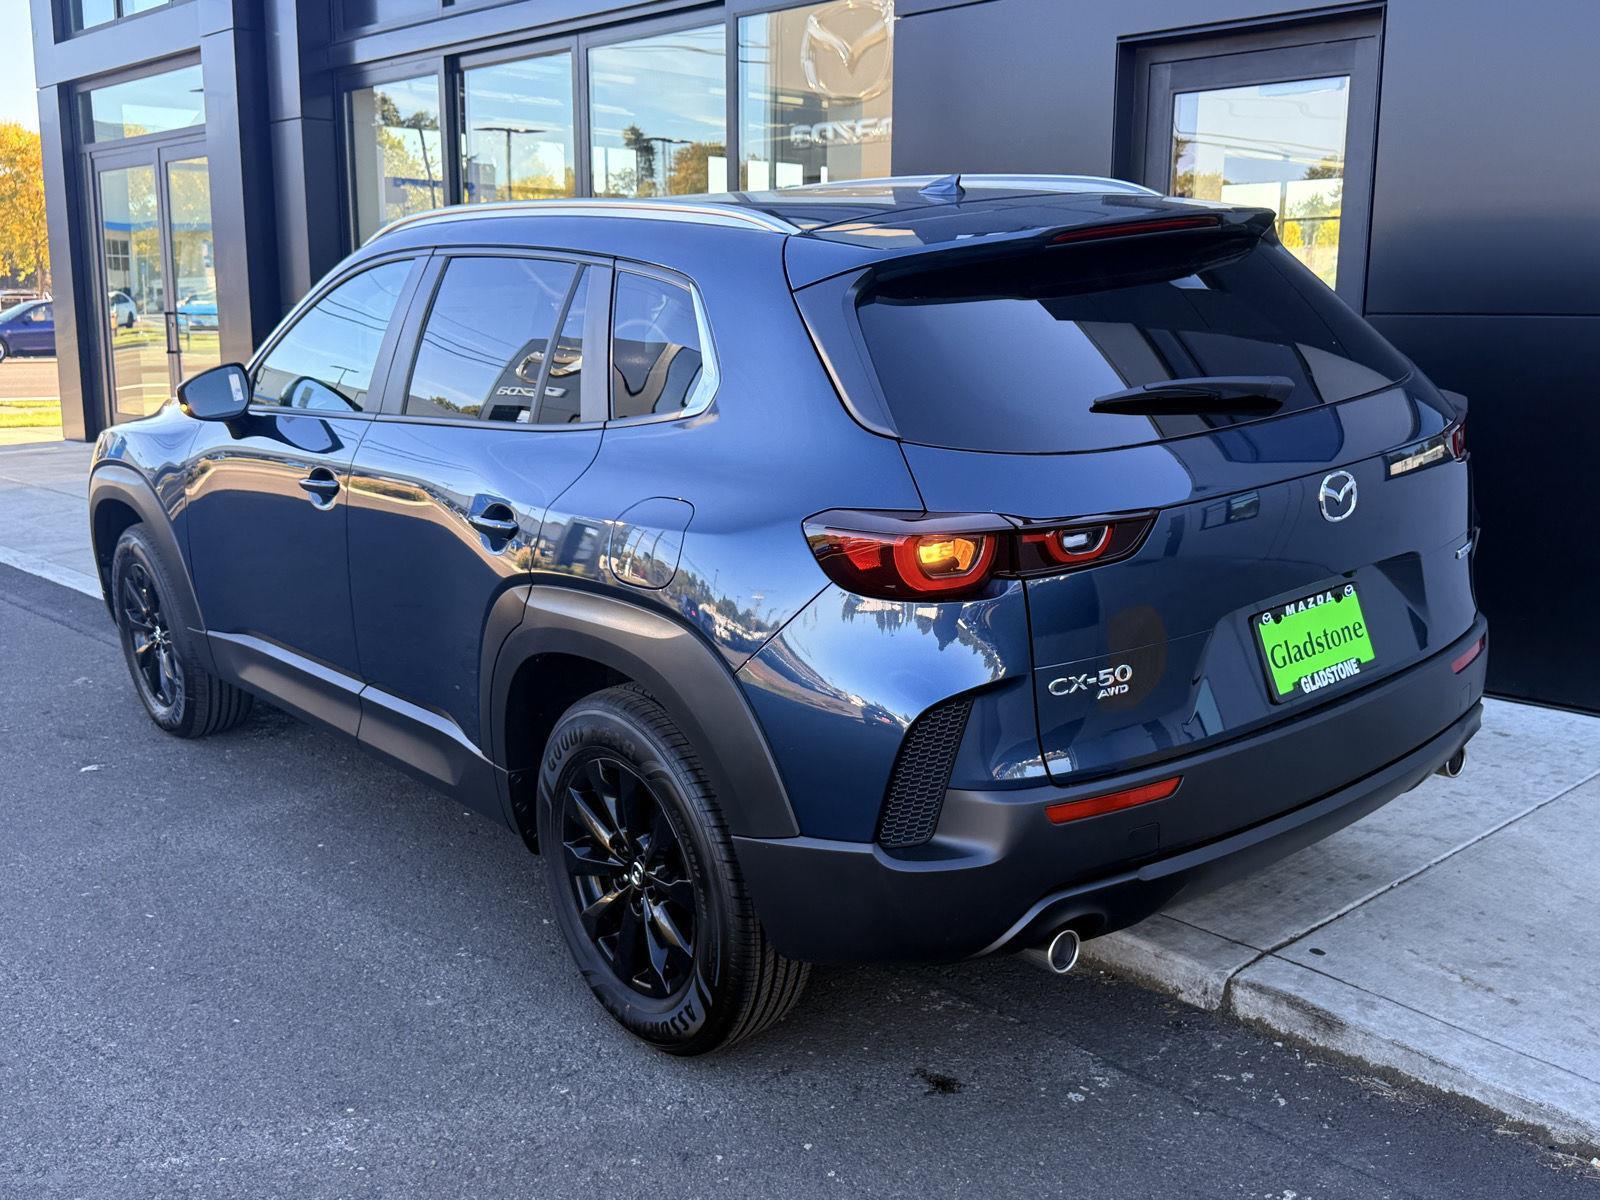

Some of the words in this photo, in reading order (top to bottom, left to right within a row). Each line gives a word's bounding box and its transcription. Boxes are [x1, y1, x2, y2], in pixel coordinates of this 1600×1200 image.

[1285, 591, 1333, 616] MAZDA
[1270, 621, 1364, 669] Gladstone
[1048, 664, 1133, 696] CX-50
[1301, 657, 1361, 694] GLADSTONE
[1097, 684, 1130, 700] AWD
